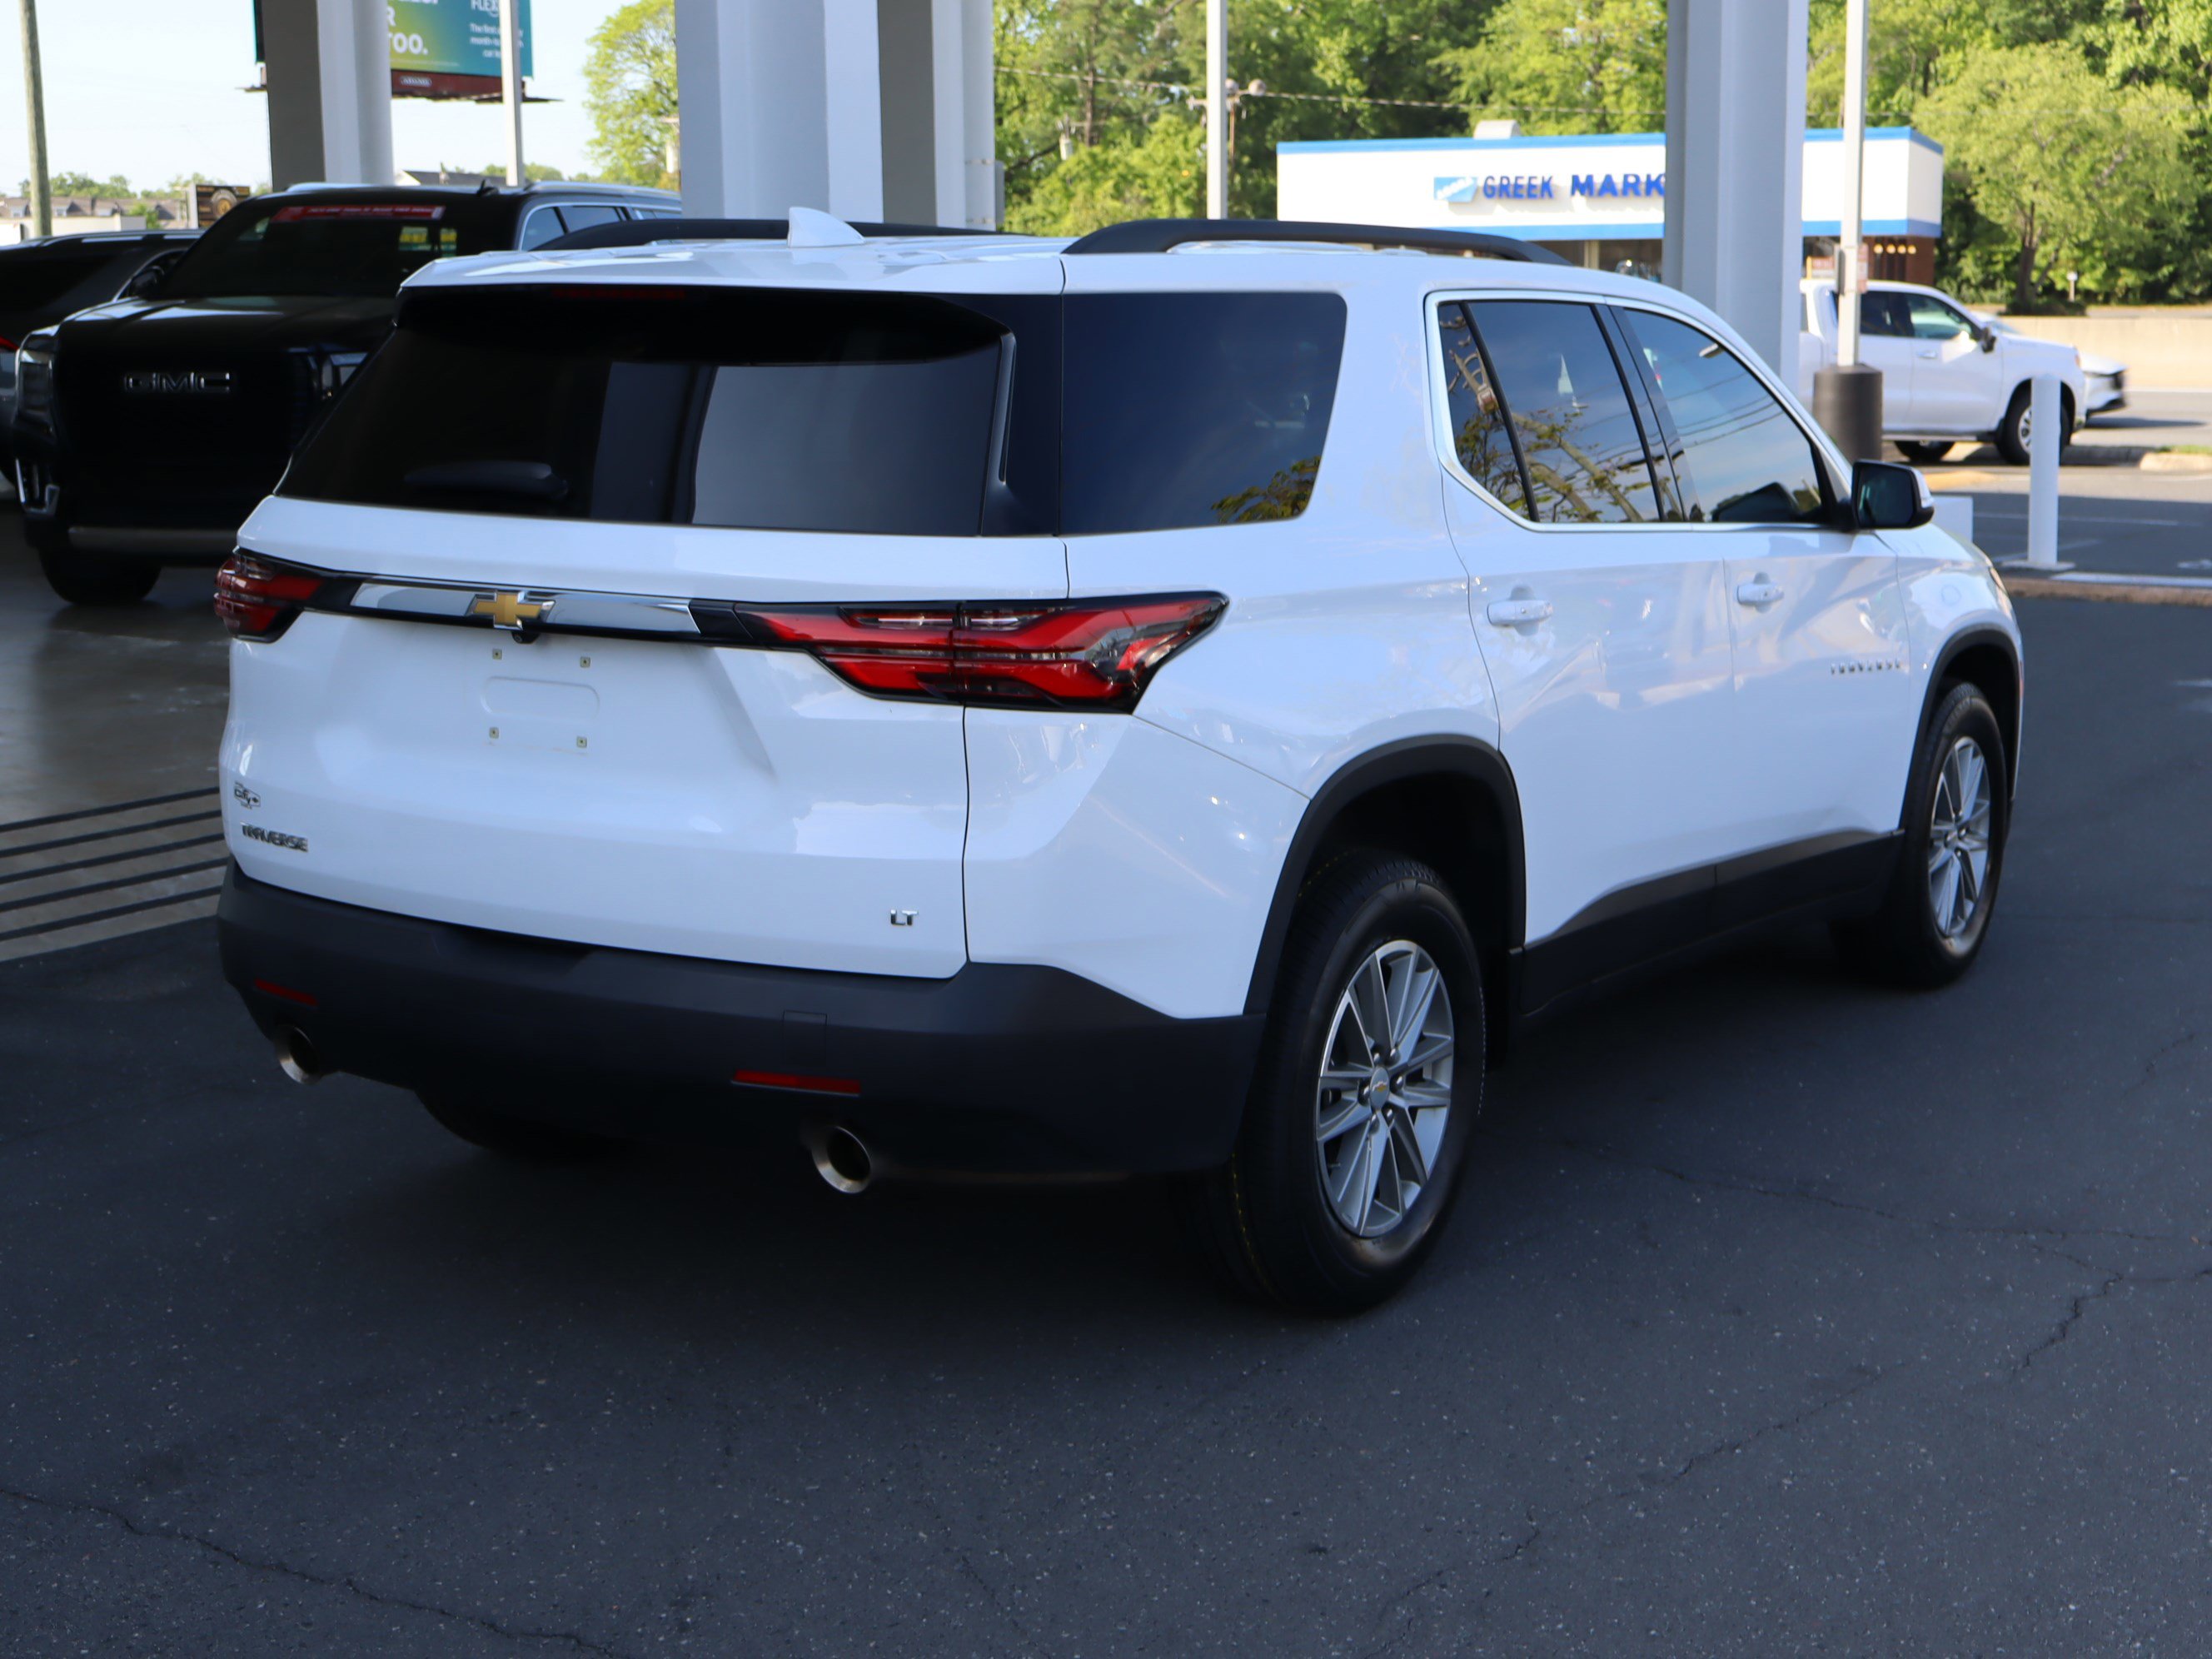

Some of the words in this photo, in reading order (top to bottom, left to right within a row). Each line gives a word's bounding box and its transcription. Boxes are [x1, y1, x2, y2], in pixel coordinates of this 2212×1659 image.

[1482, 176, 1554, 199] GREEK
[124, 371, 232, 393] GMC
[240, 821, 308, 852] TRAVERSE
[890, 909, 919, 926] LT
